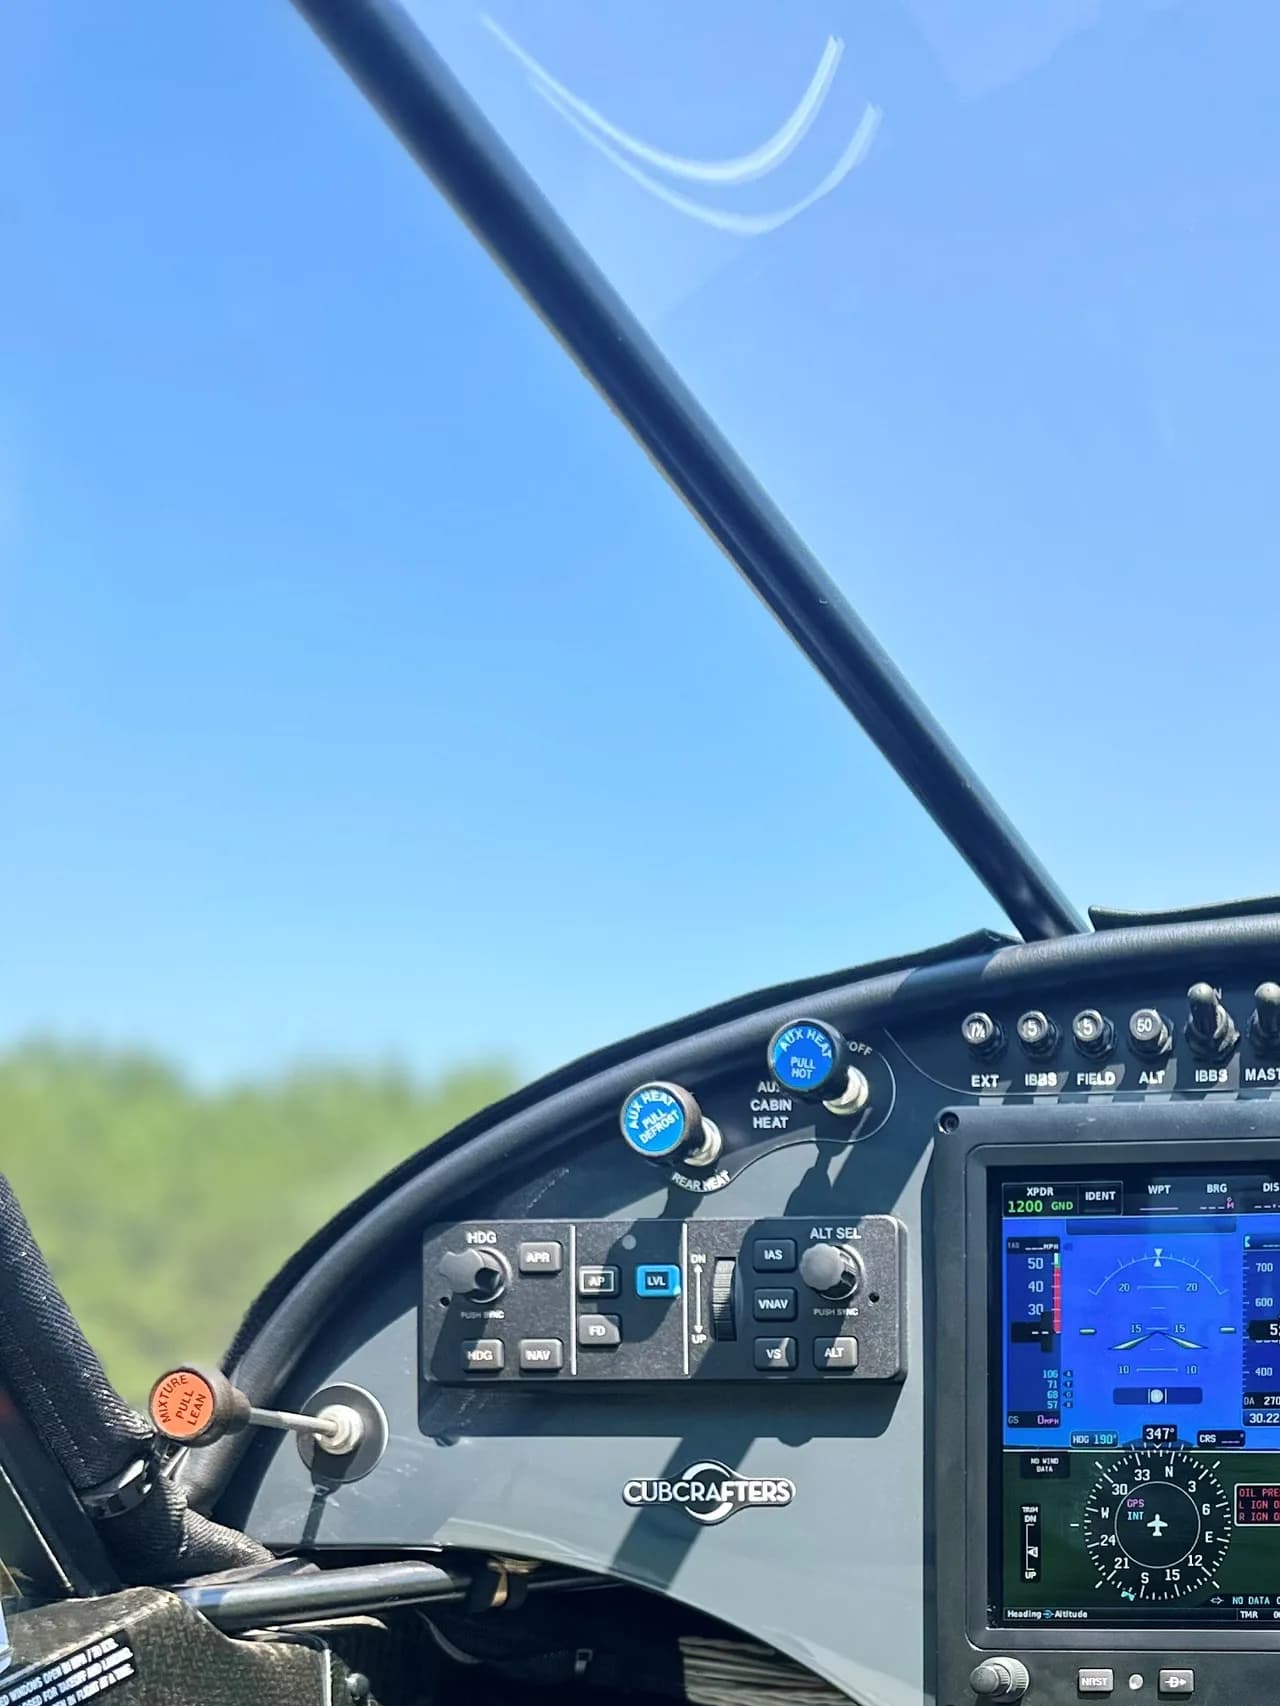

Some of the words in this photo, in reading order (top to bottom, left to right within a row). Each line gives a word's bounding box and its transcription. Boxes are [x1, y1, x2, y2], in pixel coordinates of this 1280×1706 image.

[1137, 1018, 1152, 1033] 50
[780, 1028, 803, 1052] AUX
[806, 1028, 832, 1059] HEAT
[790, 1057, 815, 1069] PULL
[792, 1068, 812, 1079] HOT
[1024, 1073, 1057, 1086] IBBS
[1077, 1071, 1116, 1086] FIELD
[1139, 1070, 1165, 1084] ALT
[1195, 1069, 1228, 1083] IBBS
[971, 1074, 999, 1087] EXT
[628, 1101, 644, 1130] AUX
[640, 1090, 676, 1107] HEAT
[750, 1100, 792, 1111] CABIN
[642, 1108, 668, 1129] PULL
[753, 1117, 788, 1128] HEAT
[638, 1110, 682, 1144] DEFROST
[671, 1171, 701, 1191] REAR
[701, 1169, 731, 1191] HEAT
[1026, 1187, 1054, 1197] XPDR
[1148, 1185, 1171, 1194] WPT
[1206, 1183, 1227, 1193] BRG
[1085, 1191, 1116, 1200] IDENT
[1008, 1200, 1043, 1213] 1200
[1051, 1201, 1073, 1211] GND
[466, 1231, 497, 1244] HDG
[810, 1227, 834, 1239] ALT
[836, 1227, 861, 1239] SEL
[526, 1253, 549, 1263] APR
[764, 1250, 782, 1260] IAS
[1028, 1258, 1044, 1269] 50
[1256, 1263, 1273, 1272] 700
[758, 1299, 788, 1309] VNAV
[1255, 1298, 1273, 1307] 600
[467, 1351, 493, 1361] HDG
[525, 1351, 550, 1361] NAV
[824, 1347, 844, 1358] ALT
[159, 1374, 189, 1423] MIXTURE
[176, 1390, 194, 1419] PULL
[187, 1393, 207, 1426] LEAN
[1199, 1434, 1216, 1443] CRS
[1134, 1469, 1150, 1481] 33
[624, 1480, 791, 1502] CUBCRAFTERS
[1112, 1484, 1128, 1496] 30
[1127, 1499, 1144, 1508] GPS
[1127, 1511, 1144, 1521] INT
[1233, 1597, 1243, 1605] NO
[1248, 1597, 1270, 1605] DATA
[1007, 1610, 1041, 1620] Heading
[1054, 1610, 1088, 1619] Altitude
[42, 1686, 59, 1702] FOR
